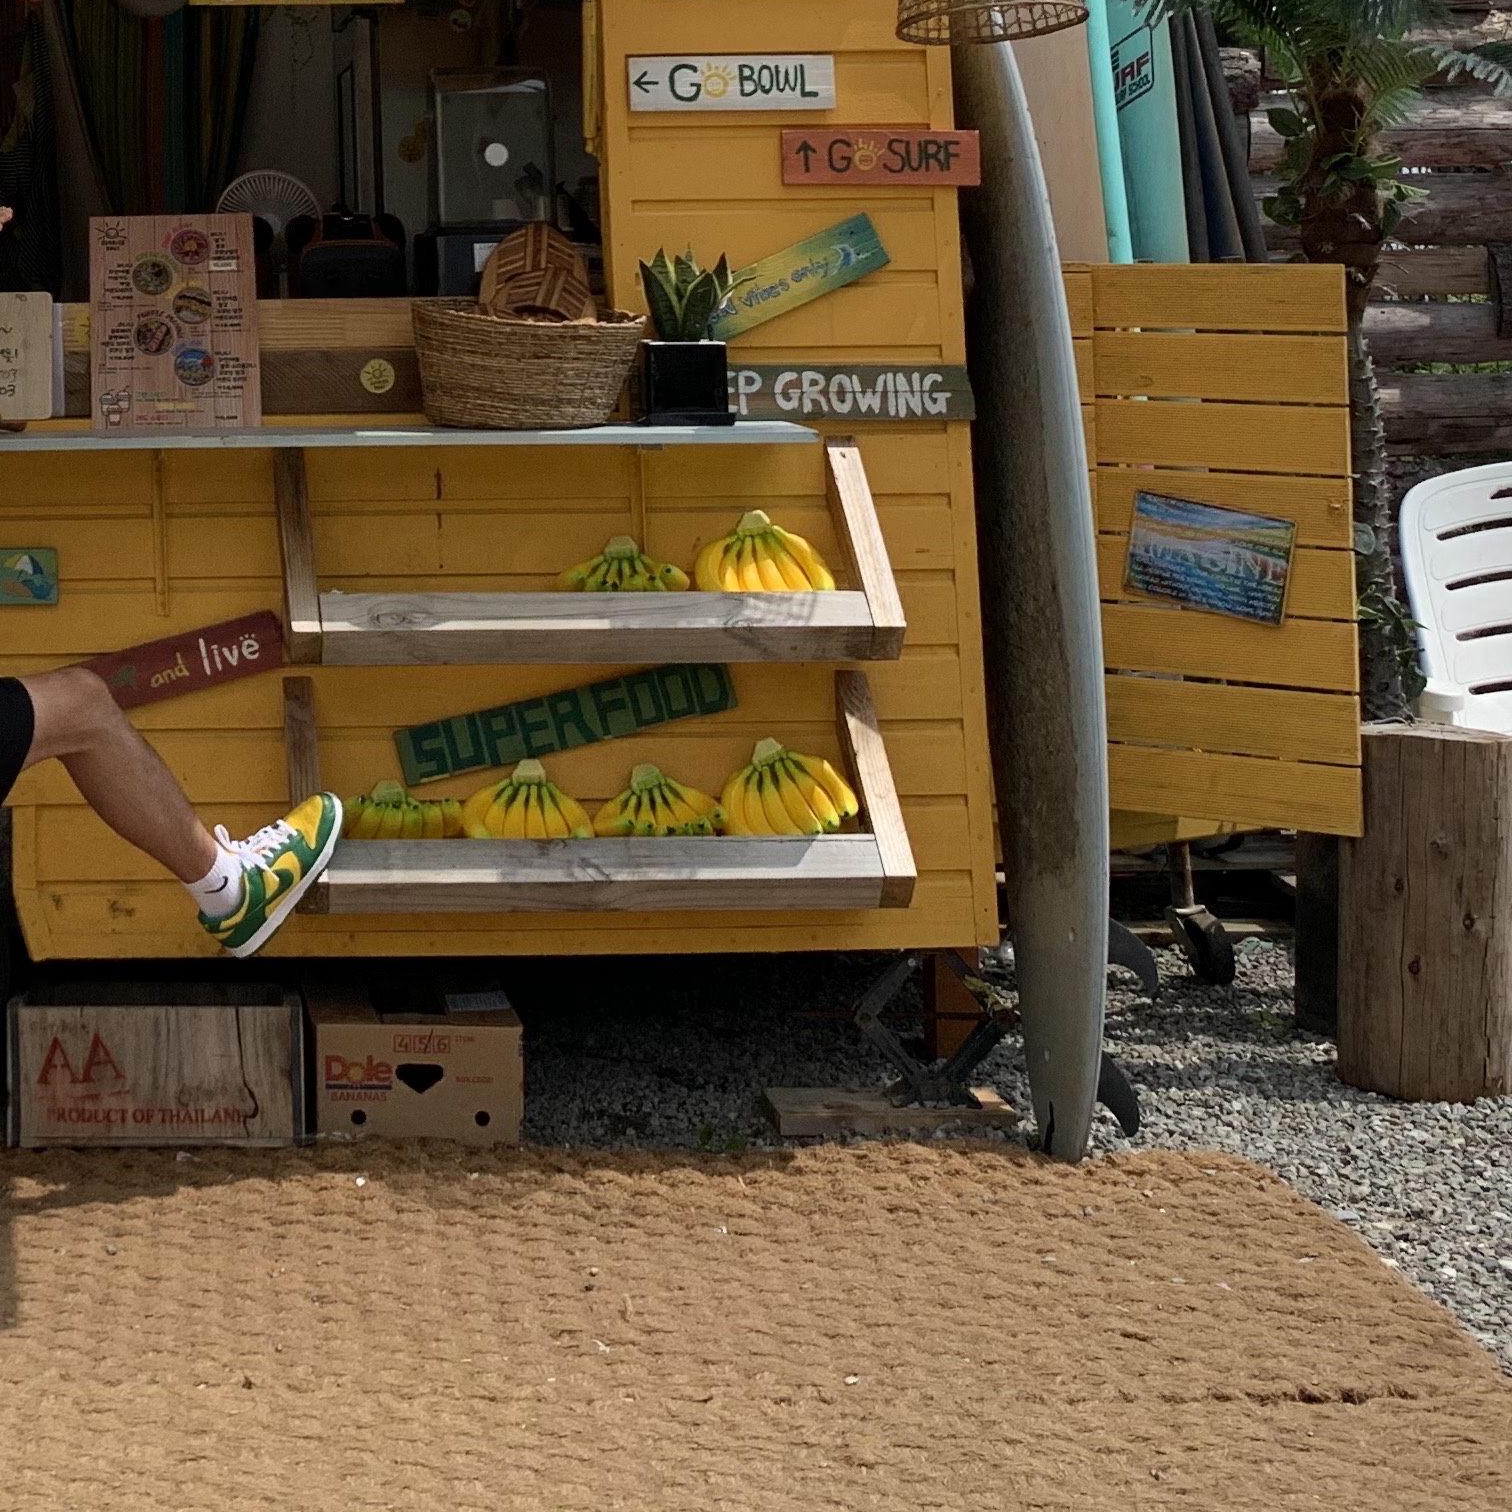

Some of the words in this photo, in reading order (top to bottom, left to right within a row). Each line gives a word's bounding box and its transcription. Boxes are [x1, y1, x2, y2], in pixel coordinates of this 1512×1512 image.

[737, 63, 819, 98] BOWL
[882, 138, 961, 174] SURF
[774, 370, 952, 418] GROWING
[149, 653, 189, 689] and
[36, 1032, 126, 1086] AA
[324, 1054, 394, 1083] Dole
[131, 1106, 155, 1123] OF
[330, 1091, 388, 1103] BANANAS
